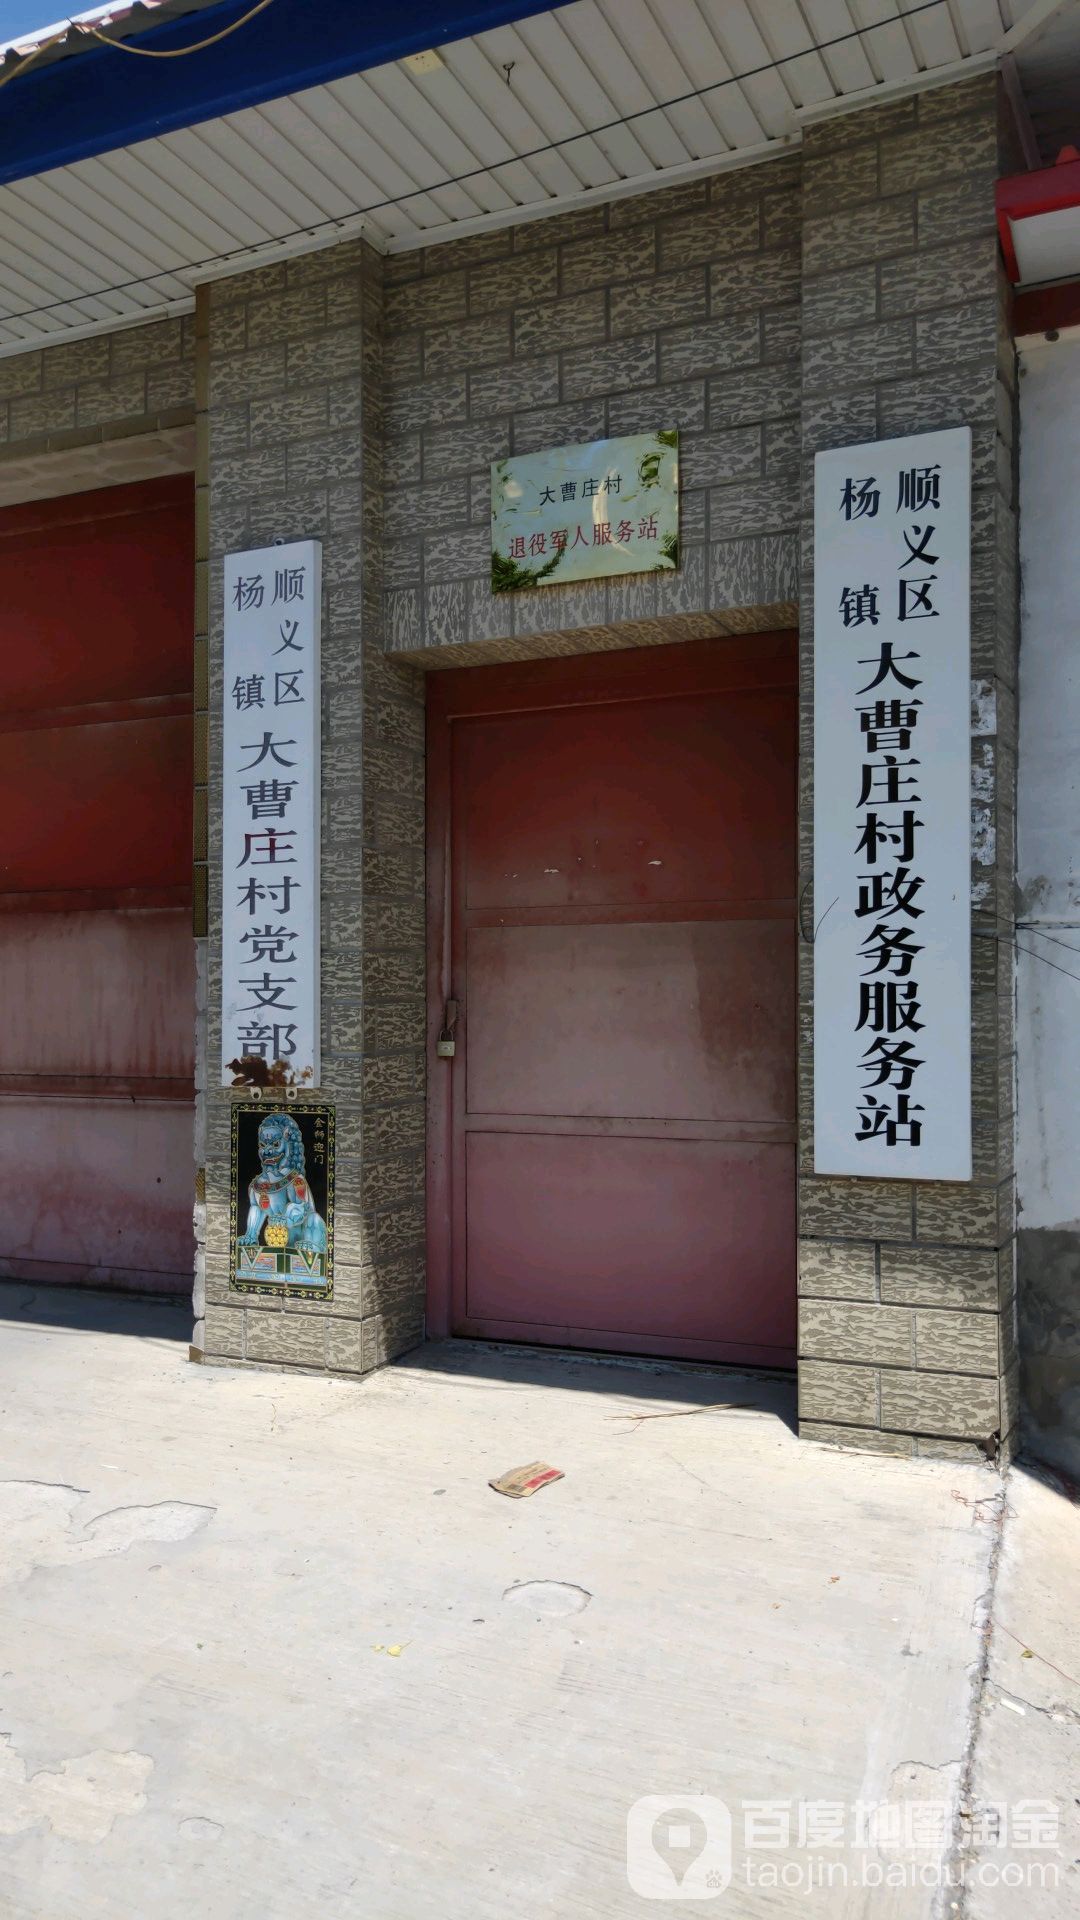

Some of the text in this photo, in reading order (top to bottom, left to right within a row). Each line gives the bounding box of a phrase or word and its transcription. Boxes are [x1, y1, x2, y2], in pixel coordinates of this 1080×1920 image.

[509, 516, 658, 559] 退役军人服务站
[539, 475, 623, 506] 大曹庄村
[838, 476, 881, 629] 杨镇
[895, 463, 942, 623] 顺义区
[231, 574, 266, 711] 杨镇
[271, 566, 306, 707] 顺义区
[234, 731, 301, 1060] 大曹庄村党支部
[853, 641, 927, 1147] 大曹庄村政务服务站
